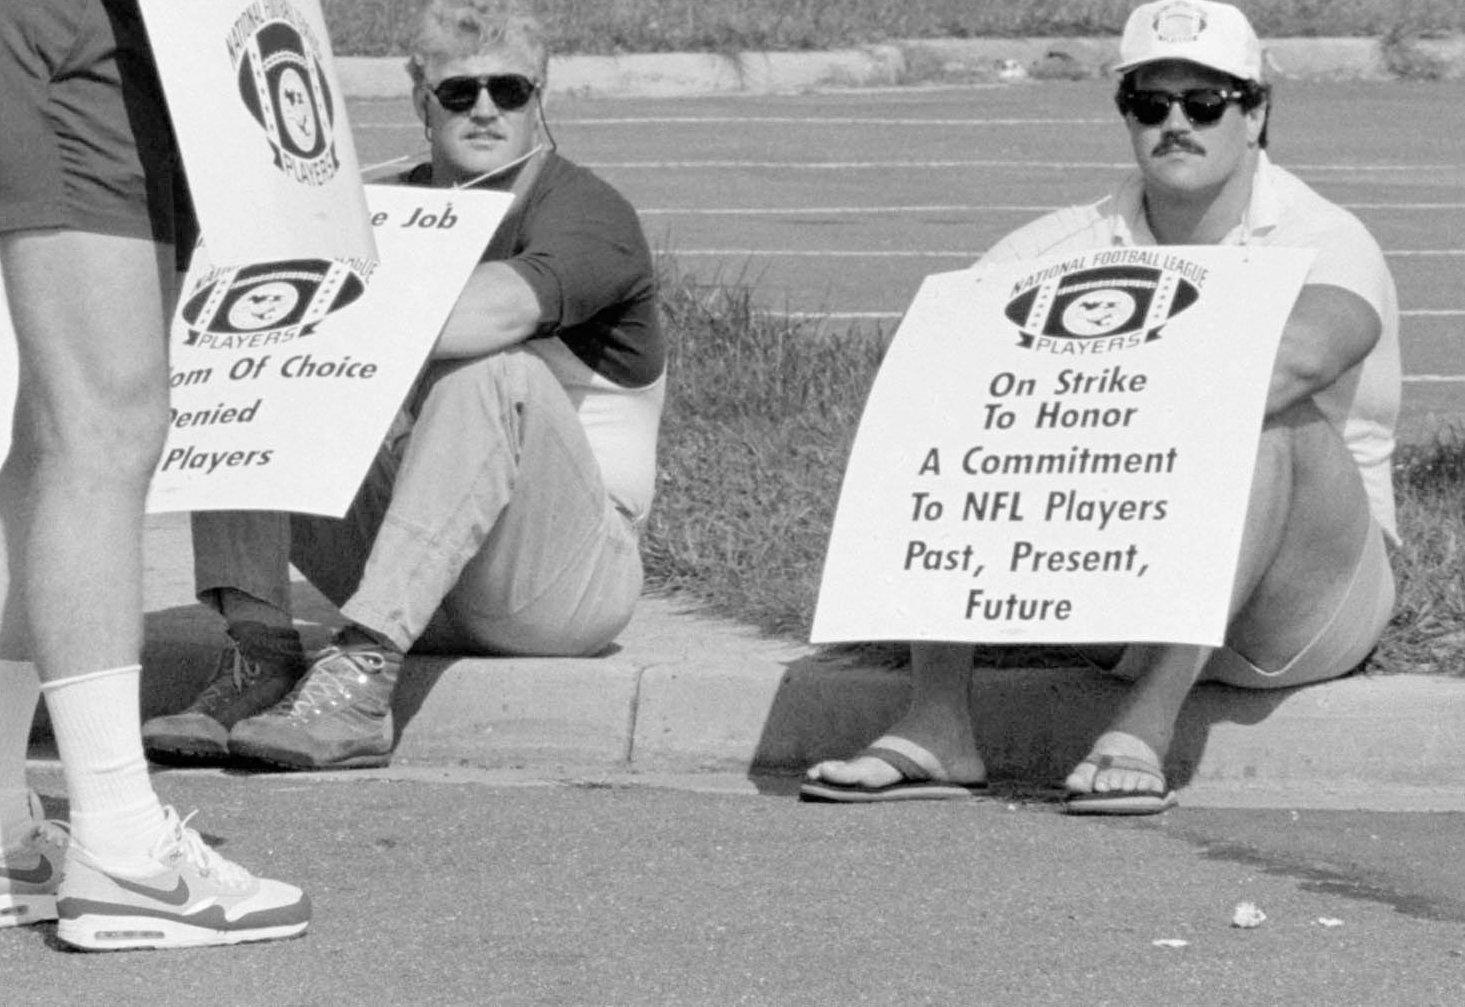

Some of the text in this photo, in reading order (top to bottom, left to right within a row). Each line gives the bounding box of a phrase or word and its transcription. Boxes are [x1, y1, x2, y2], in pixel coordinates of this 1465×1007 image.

[401, 205, 458, 229] Job
[1010, 250, 1208, 298] NATIONAL FOOTBALL LEAGUE
[197, 326, 299, 350] PLAYERS
[1035, 331, 1143, 355] PLAYERS
[229, 355, 272, 380] Of
[280, 354, 378, 379] Choice
[989, 366, 1148, 398] On Strike
[984, 402, 1139, 429] To Honor
[161, 445, 275, 474] Players
[918, 446, 1177, 475] A Commitment
[911, 490, 1168, 530] To NFL Players
[903, 541, 1149, 577] Past, Present,
[965, 589, 1072, 620] Future
